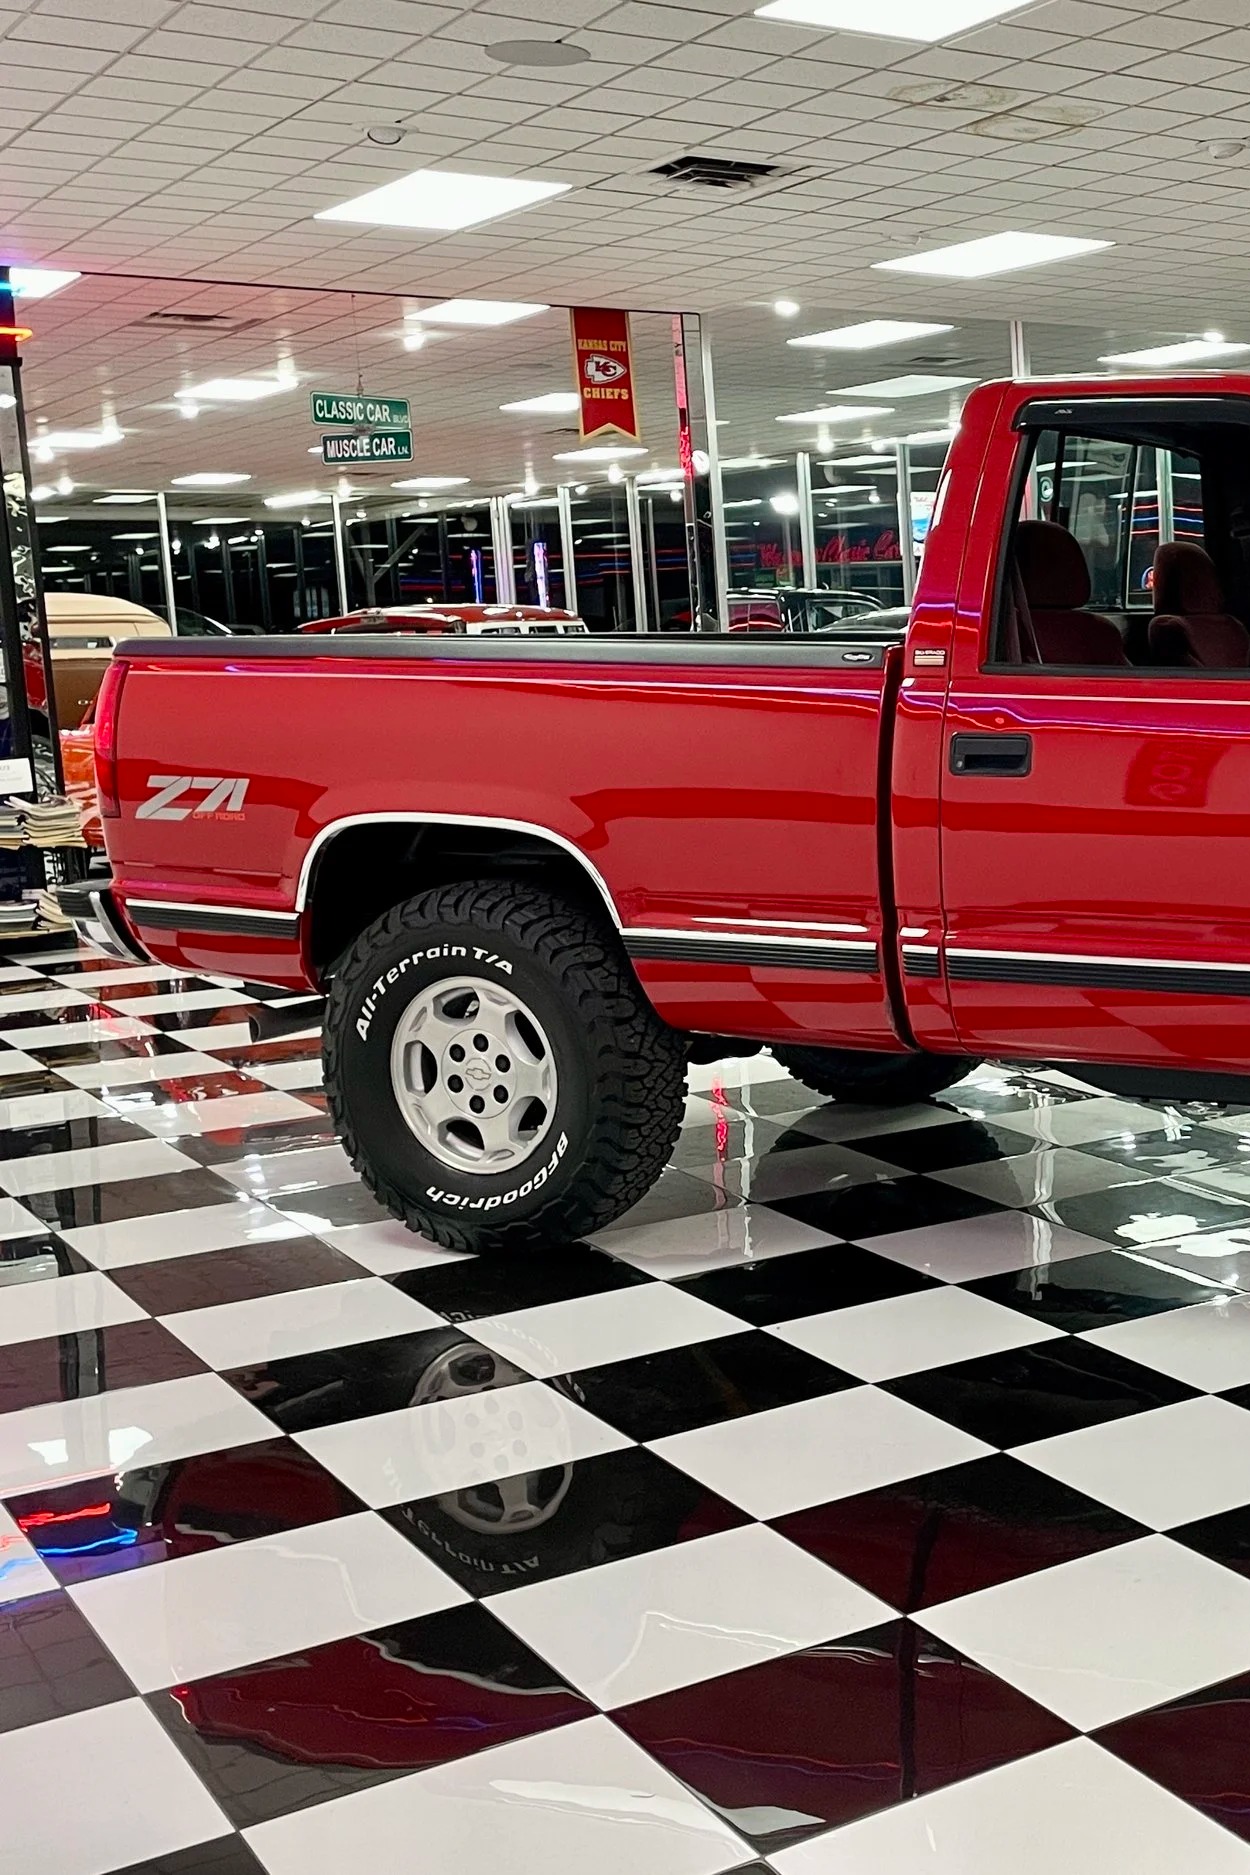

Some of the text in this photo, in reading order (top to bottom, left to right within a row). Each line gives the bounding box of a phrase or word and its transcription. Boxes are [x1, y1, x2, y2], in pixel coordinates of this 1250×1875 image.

[578, 339, 627, 352] KANSAS CITY
[583, 387, 629, 400] CHIEFS
[315, 399, 365, 421] CLASSIC
[366, 404, 391, 423] CAR
[326, 438, 371, 458] MUSCLE
[372, 437, 396, 456] CAR
[135, 774, 250, 821] Z71
[192, 811, 213, 820] OFF
[355, 943, 513, 1042] All-Terrain T/A
[425, 1130, 569, 1211] BFGoodrich
